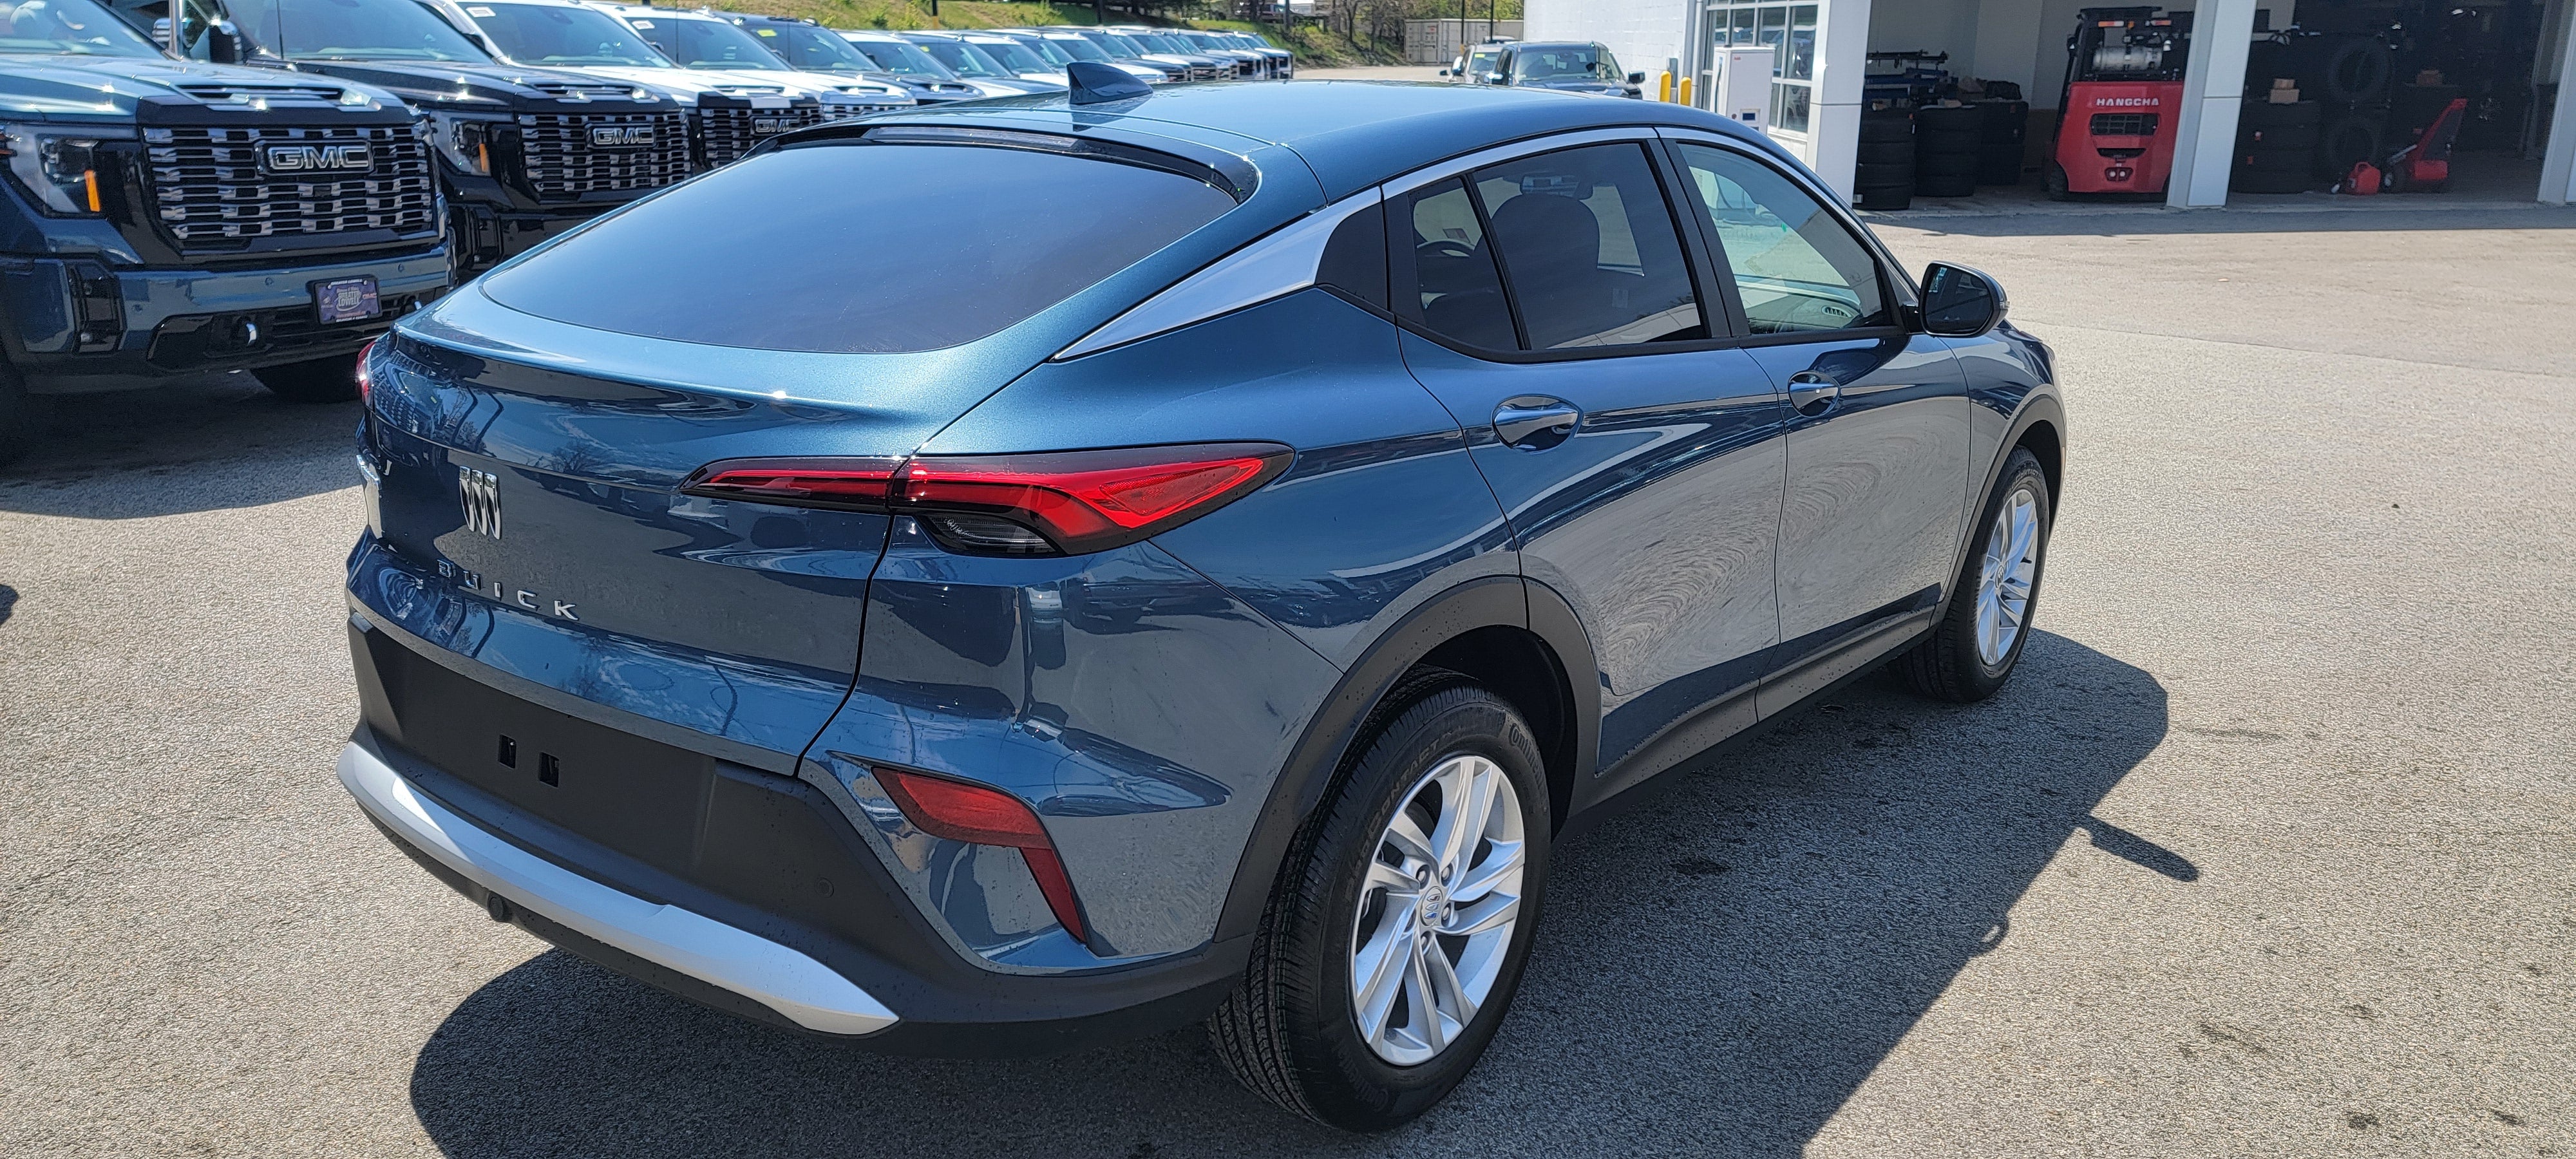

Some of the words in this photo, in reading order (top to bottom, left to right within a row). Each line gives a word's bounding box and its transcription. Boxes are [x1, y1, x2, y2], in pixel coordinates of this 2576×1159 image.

[2096, 98, 2159, 106] HANGCHA
[755, 118, 800, 133] GMC
[593, 127, 654, 145] GMC
[267, 146, 369, 170] GMC
[437, 559, 578, 620] BUICK
